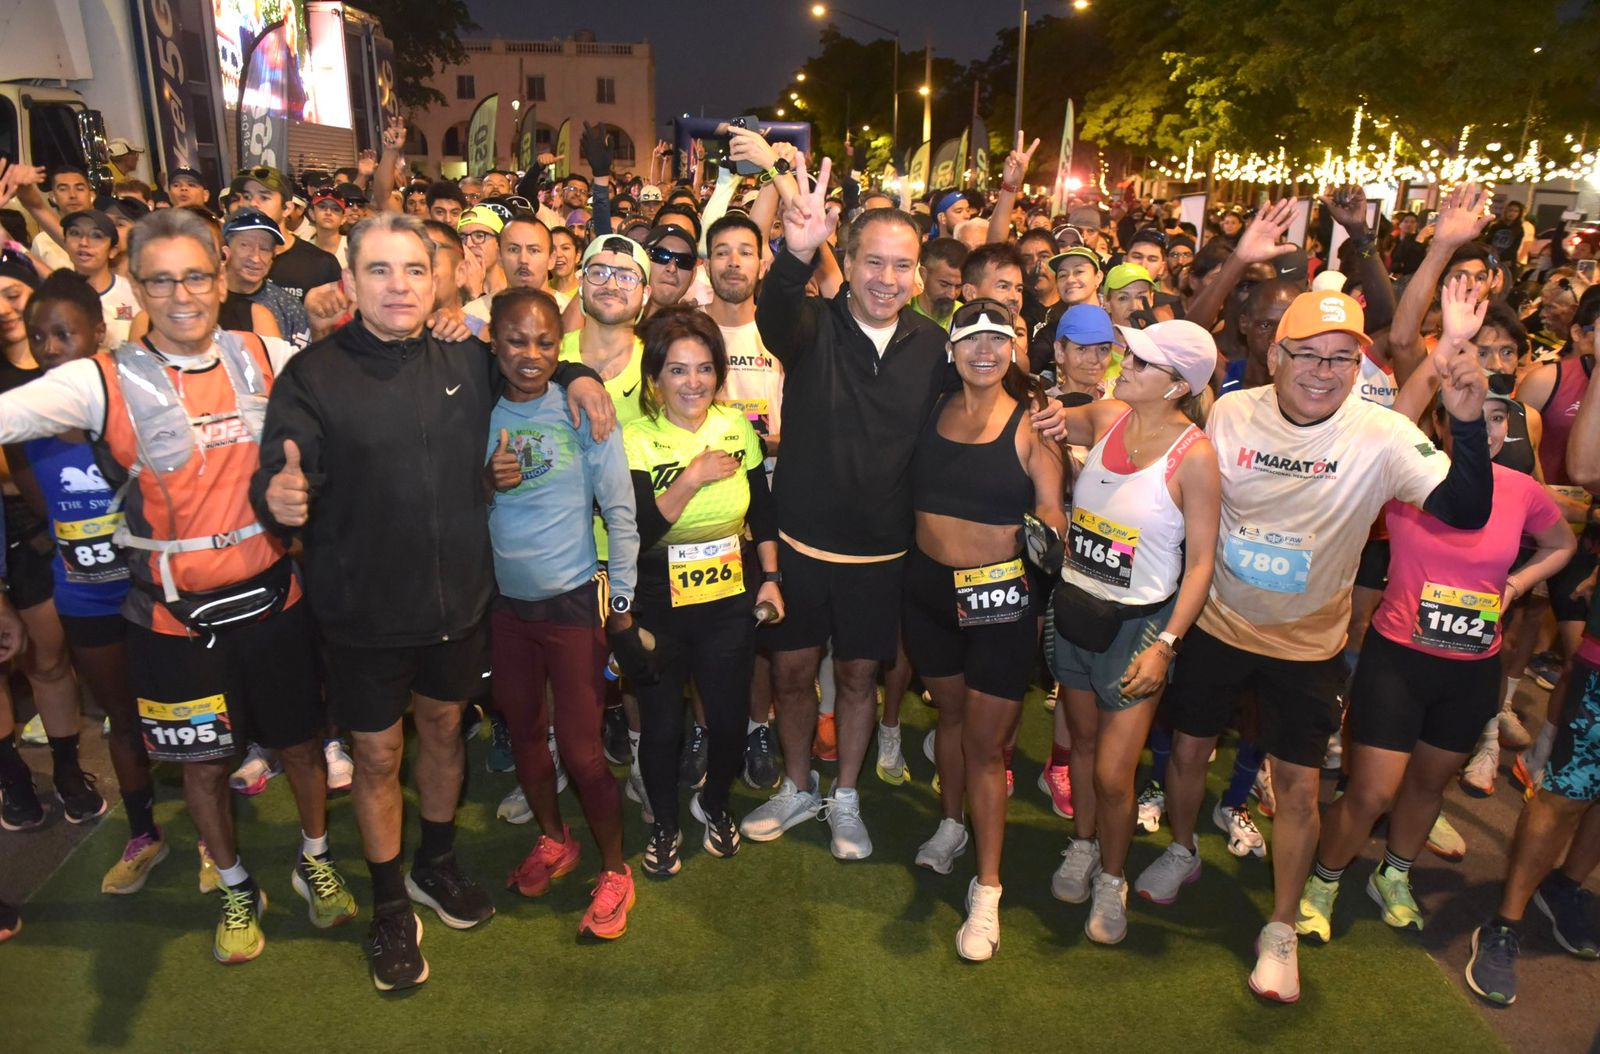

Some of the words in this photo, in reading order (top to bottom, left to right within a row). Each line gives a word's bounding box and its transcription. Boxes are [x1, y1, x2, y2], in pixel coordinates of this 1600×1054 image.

[729, 353, 772, 368] RATÓN
[1361, 384, 1397, 396] Chevr
[1237, 447, 1256, 469] H
[1255, 451, 1338, 474] MARATÓN
[58, 501, 82, 511] THE
[89, 499, 114, 510] SWA
[75, 542, 115, 566] 83
[1075, 535, 1121, 569] 1165
[1238, 549, 1290, 576] 780
[678, 563, 732, 589] 1926
[966, 586, 1020, 610] 1196
[1427, 611, 1485, 638] 1162
[151, 723, 217, 746] 1195
